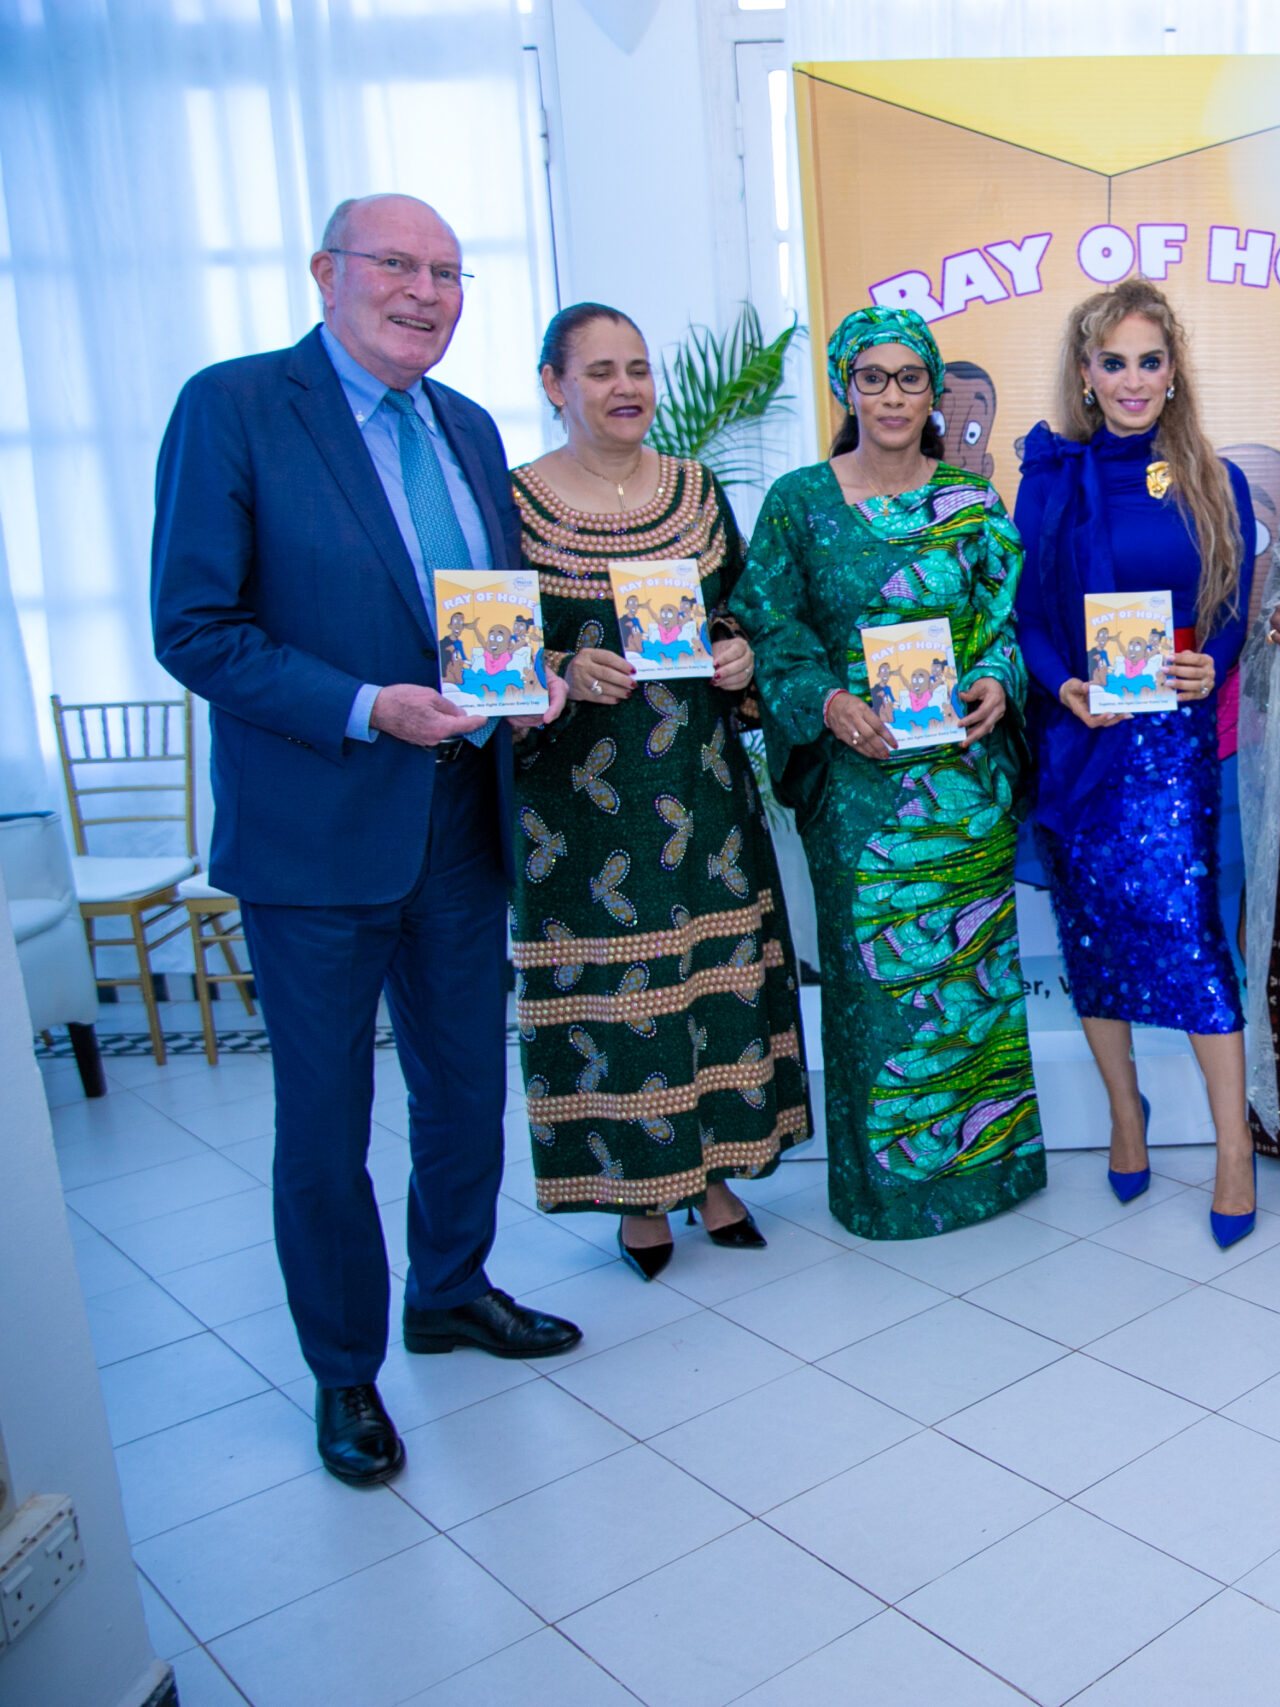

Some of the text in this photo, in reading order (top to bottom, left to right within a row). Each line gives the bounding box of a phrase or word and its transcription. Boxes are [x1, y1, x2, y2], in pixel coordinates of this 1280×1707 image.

[869, 232, 1053, 324] RAY
[1077, 223, 1187, 285] OF
[442, 593, 472, 611] RAY
[475, 592, 494, 602] OF
